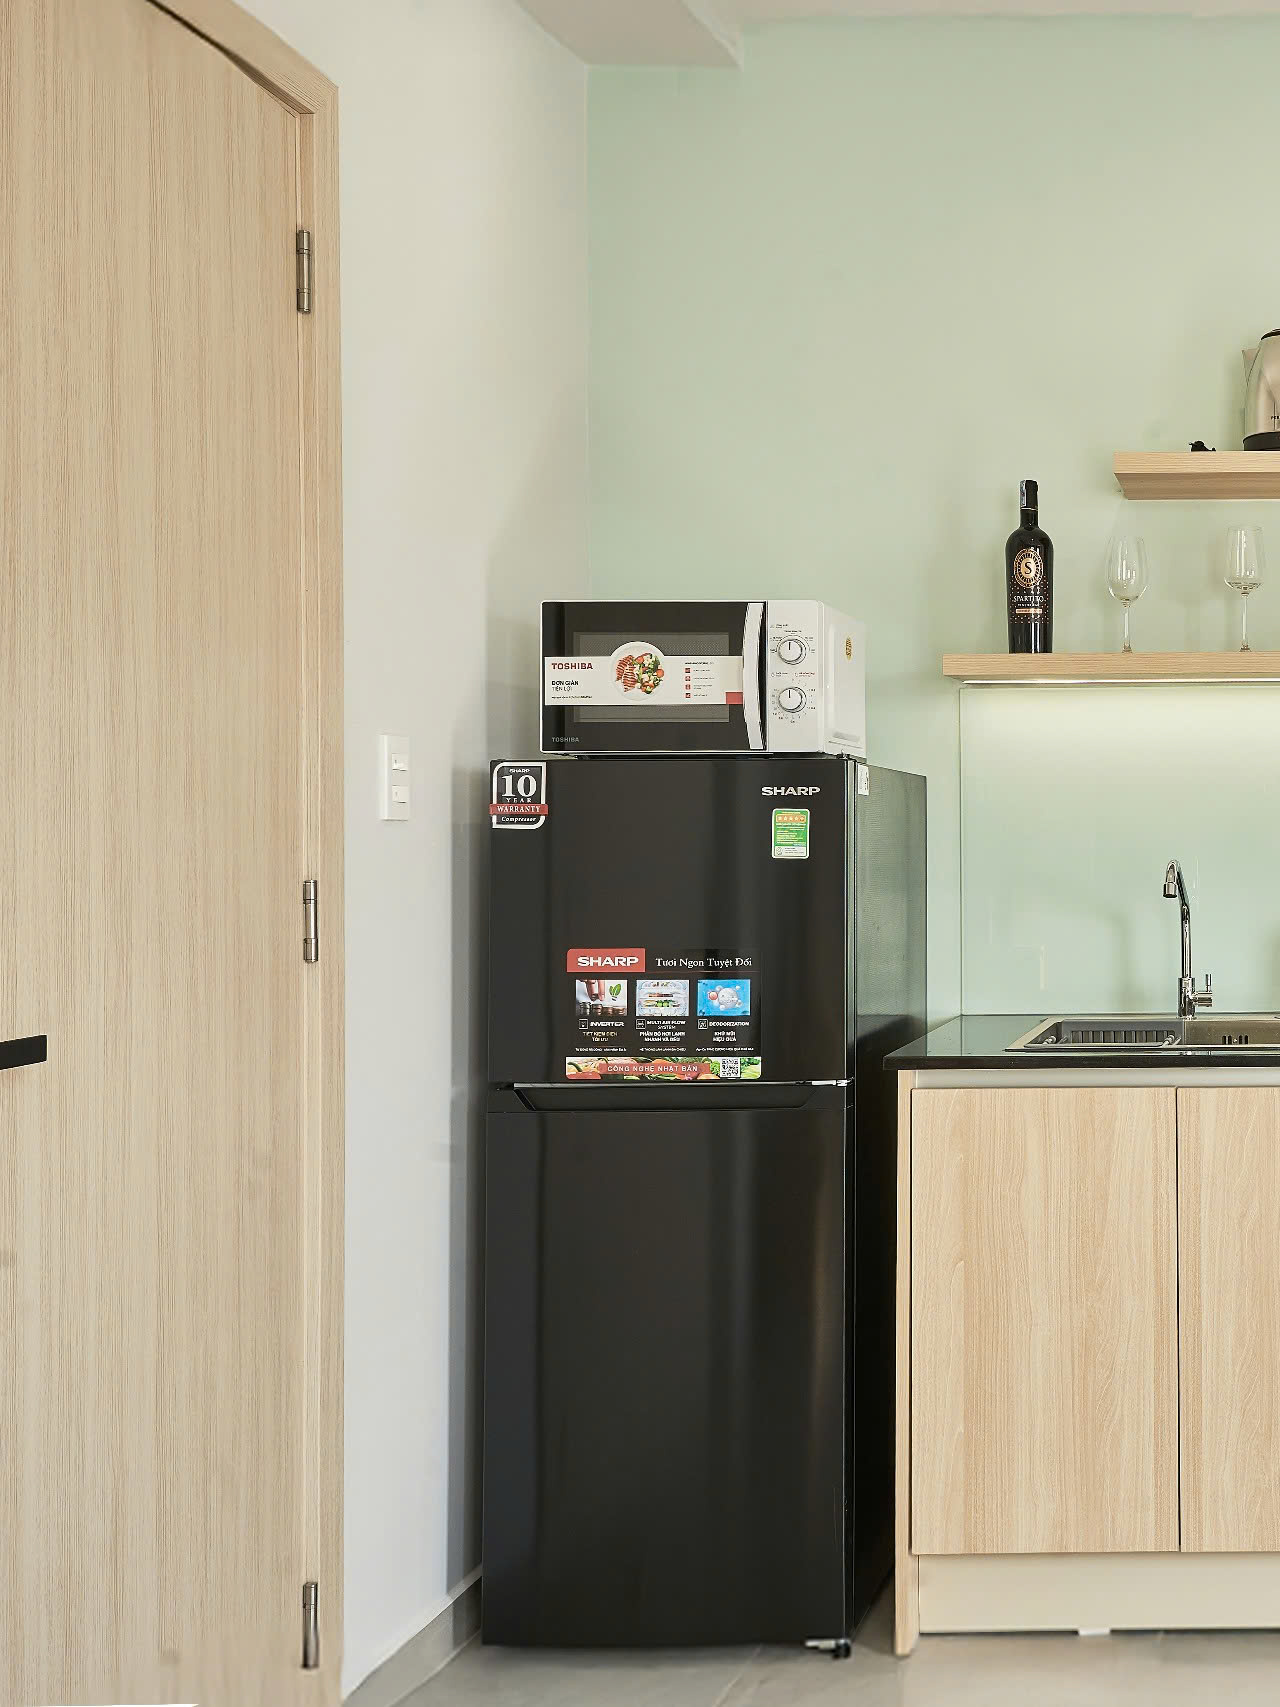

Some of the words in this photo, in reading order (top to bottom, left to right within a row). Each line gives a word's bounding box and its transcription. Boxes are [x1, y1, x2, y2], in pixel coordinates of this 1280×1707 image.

[1025, 562, 1032, 574] S
[1013, 595, 1044, 603] SPARTITO
[551, 662, 593, 670] TOSHIBA
[501, 774, 537, 797] 10
[761, 785, 821, 796] SHARP
[496, 805, 541, 813] WARRANTY
[577, 956, 639, 967] SHARP
[655, 957, 678, 967] Tươi
[679, 958, 704, 969] Ngon
[706, 957, 733, 969] Tuyệt
[735, 957, 752, 967] Đối
[607, 1064, 630, 1072] CÔNG
[681, 1064, 698, 1072] BẢN
